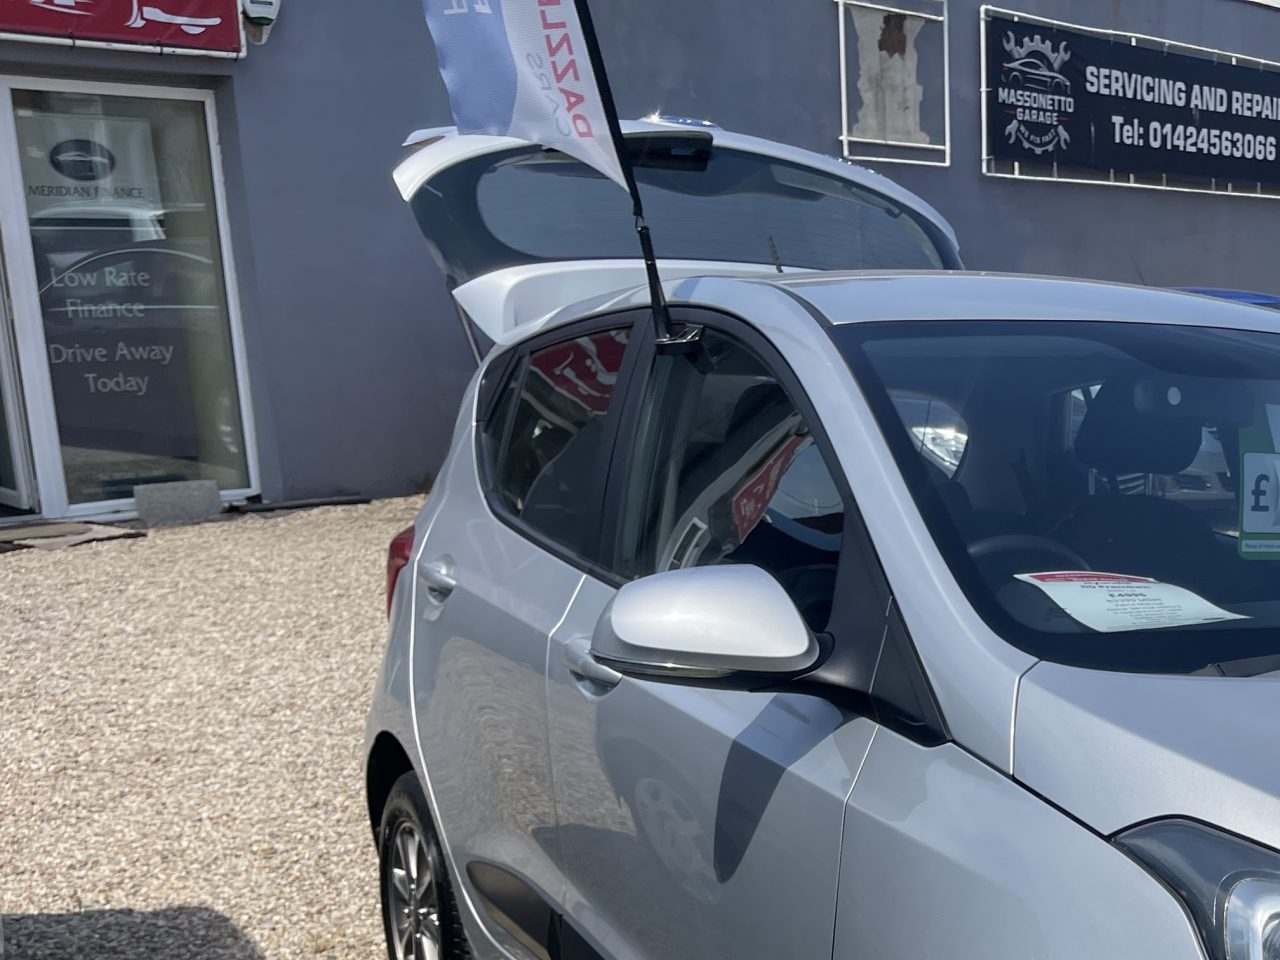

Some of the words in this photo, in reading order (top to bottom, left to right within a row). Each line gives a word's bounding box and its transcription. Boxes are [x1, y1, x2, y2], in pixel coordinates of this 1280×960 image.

[998, 87, 1075, 113] MASSONETTO
[1085, 65, 1187, 107] SERVICING
[1190, 84, 1228, 113] AND
[1016, 108, 1059, 125] GARAGE
[1111, 115, 1144, 147] Tel:
[1149, 121, 1277, 161] 01424563066
[28, 185, 92, 198] MERIDIAN
[94, 186, 145, 199] FANCE
[51, 266, 97, 288] Low
[104, 266, 151, 288] Rate
[66, 298, 145, 319] Finance
[50, 343, 108, 364] Drive
[115, 341, 174, 365] Away
[84, 373, 149, 396] Today
